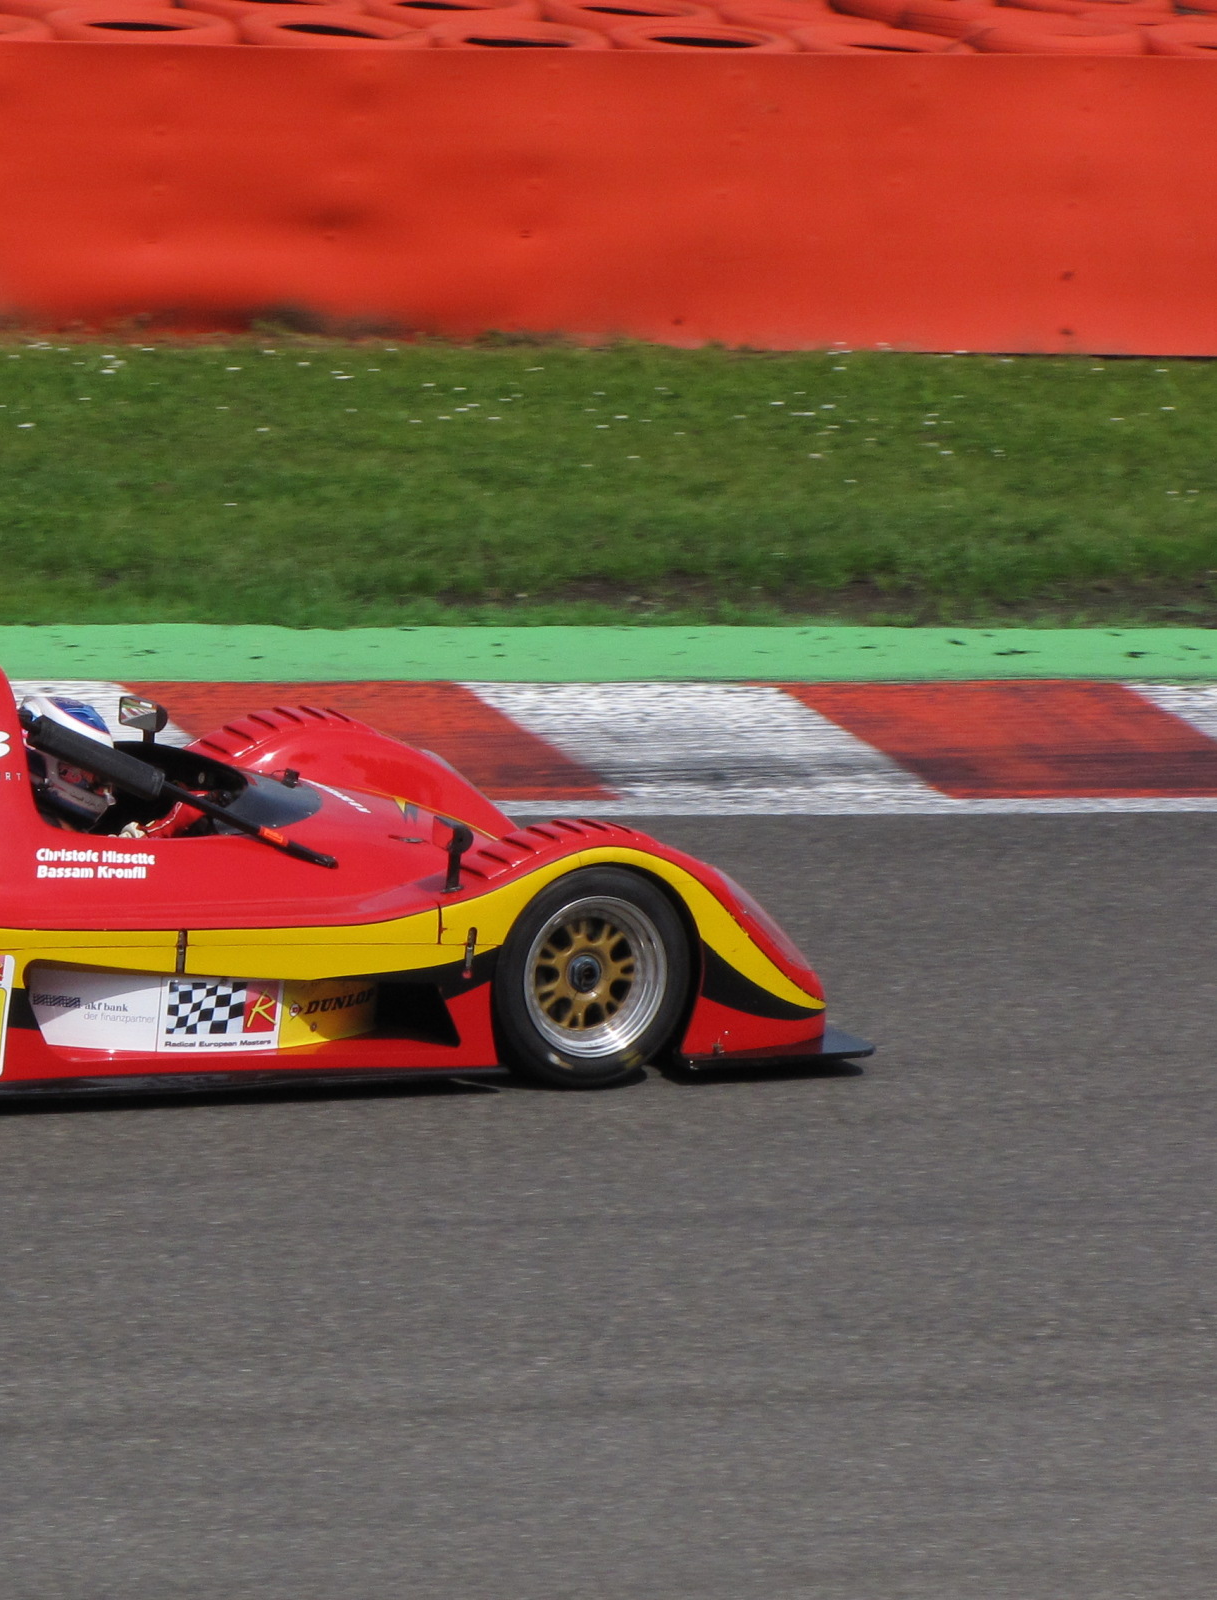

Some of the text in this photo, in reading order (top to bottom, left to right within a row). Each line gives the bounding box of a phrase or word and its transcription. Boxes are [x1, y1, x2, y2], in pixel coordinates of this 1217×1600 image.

[36, 848, 156, 865] Christofe Hissette
[37, 865, 95, 878] Bassam
[84, 1002, 128, 1012] akf bank
[304, 988, 375, 1015] DUNLOP
[83, 1012, 155, 1024] der finanzpartner
[165, 1038, 272, 1048] Radical European Masters
